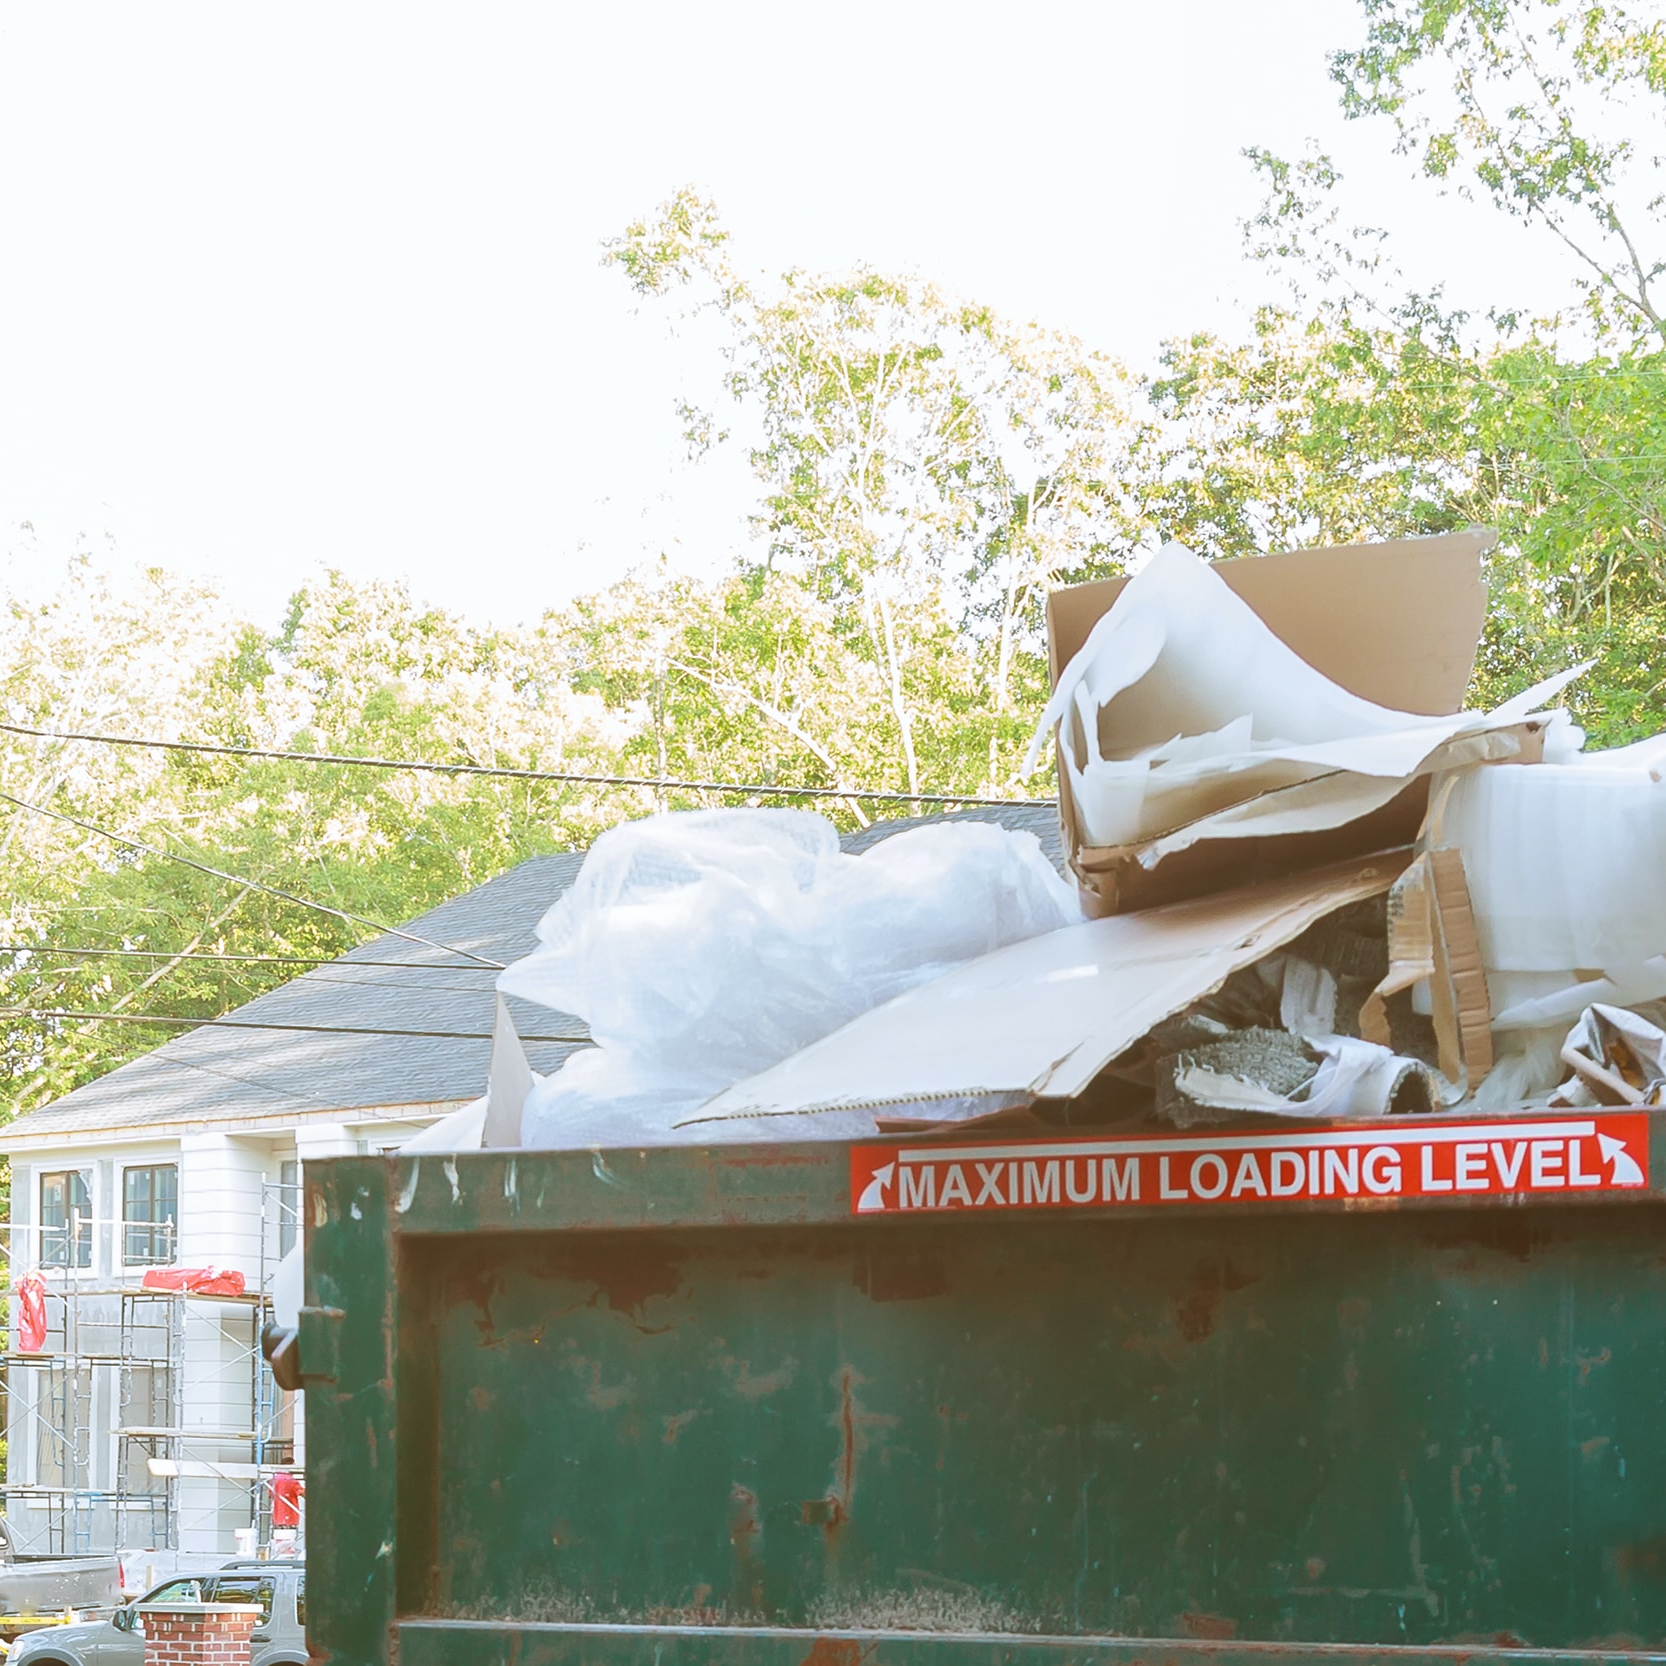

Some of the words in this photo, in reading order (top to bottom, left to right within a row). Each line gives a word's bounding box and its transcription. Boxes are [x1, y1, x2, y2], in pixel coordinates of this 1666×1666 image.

[898, 1157, 1141, 1209] MAXIMUM
[1159, 1146, 1402, 1200] LOADING
[1421, 1139, 1601, 1192] LEVEL
